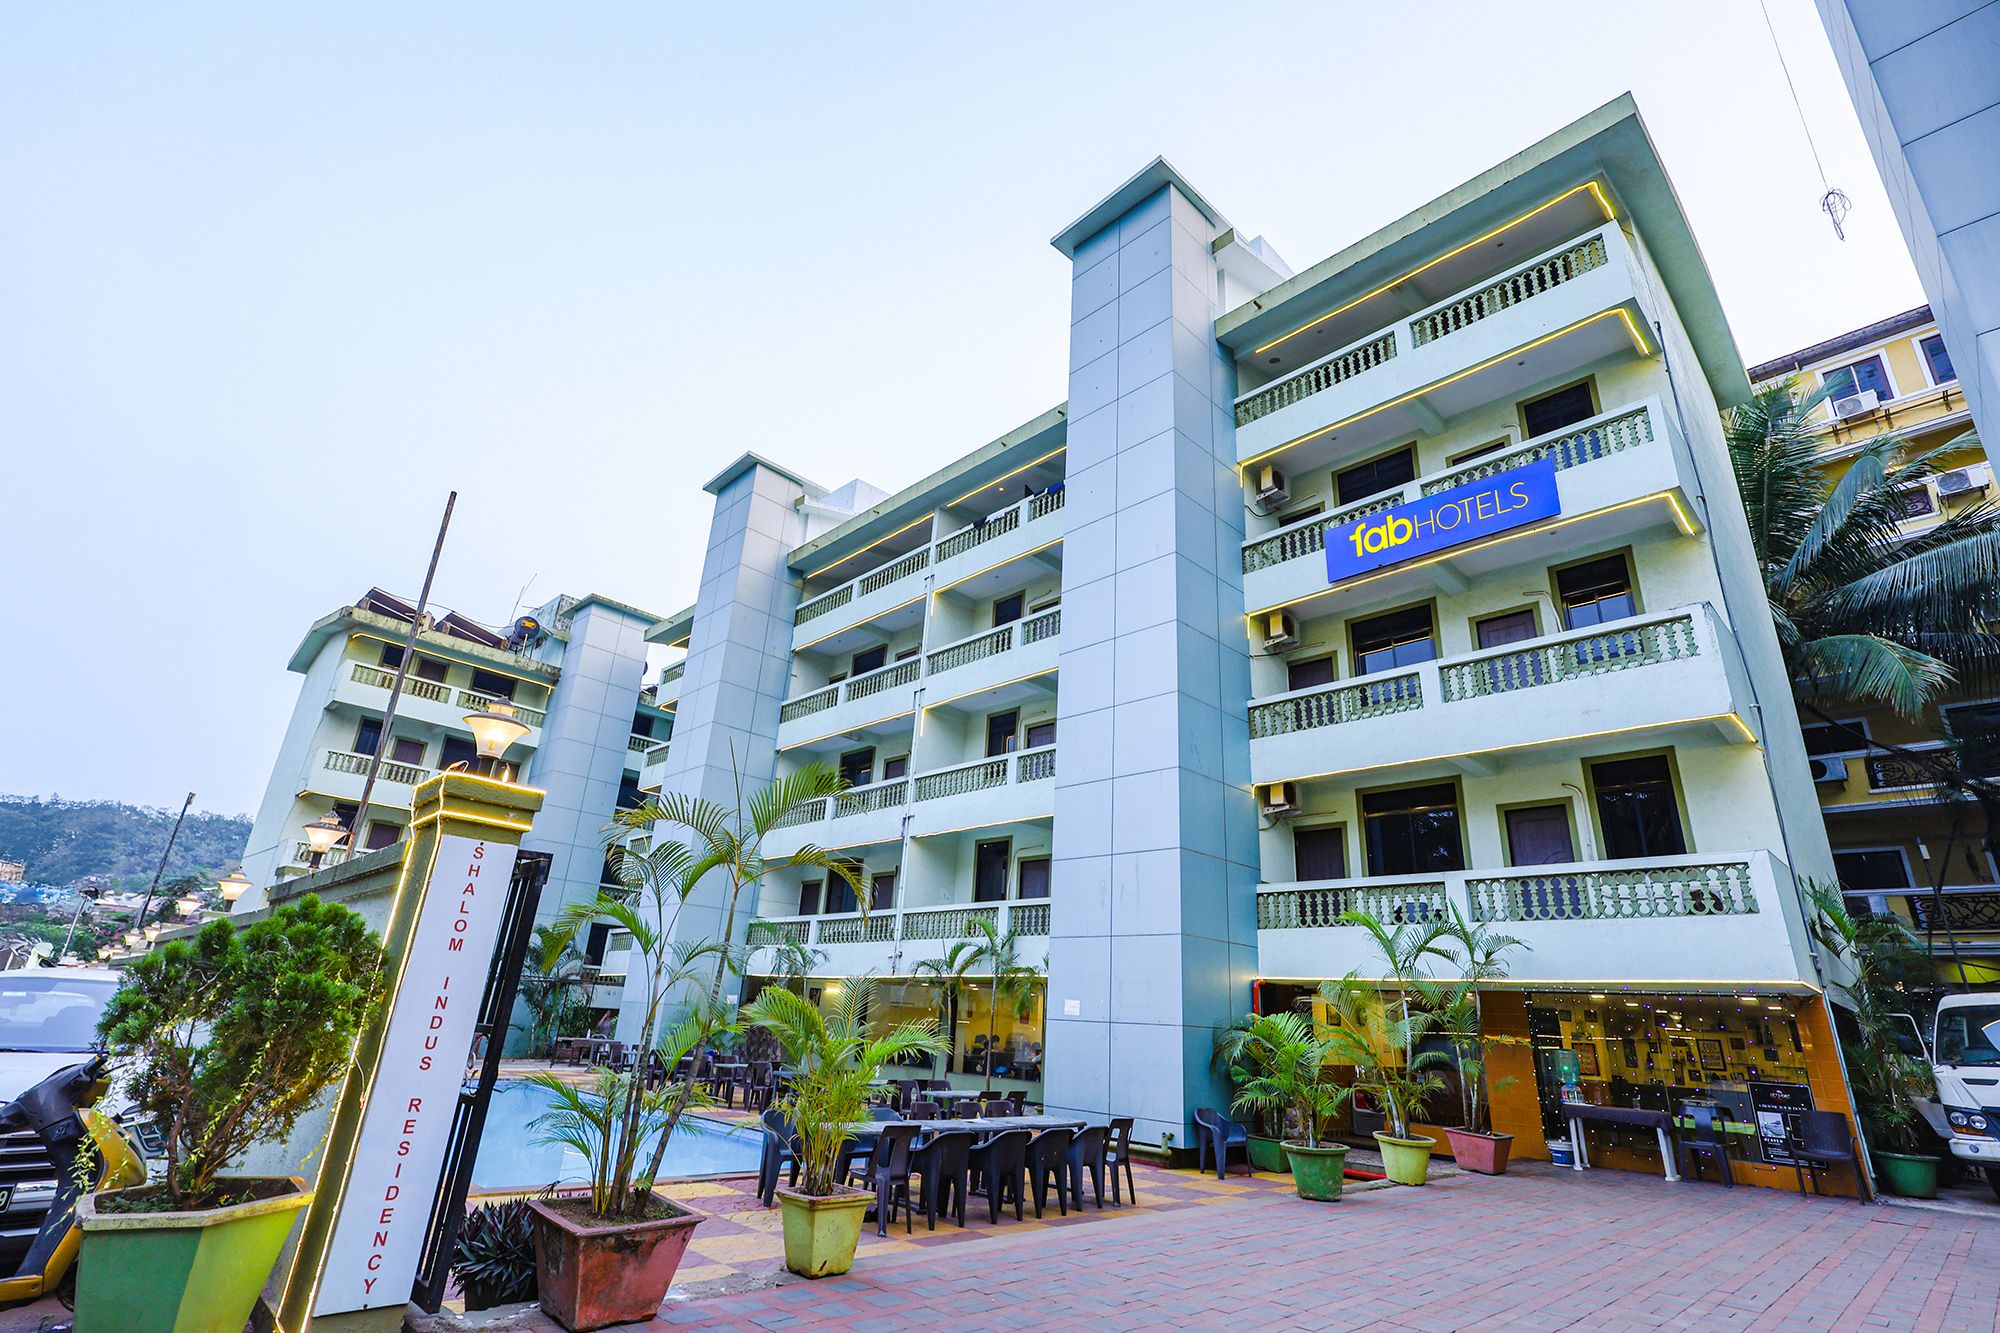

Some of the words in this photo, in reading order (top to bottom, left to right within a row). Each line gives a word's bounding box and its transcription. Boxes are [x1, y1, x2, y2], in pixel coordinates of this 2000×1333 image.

[447, 846, 484, 952] SHALOM
[418, 976, 450, 1071] INDUS
[362, 1098, 422, 1295] RESIDENCY
